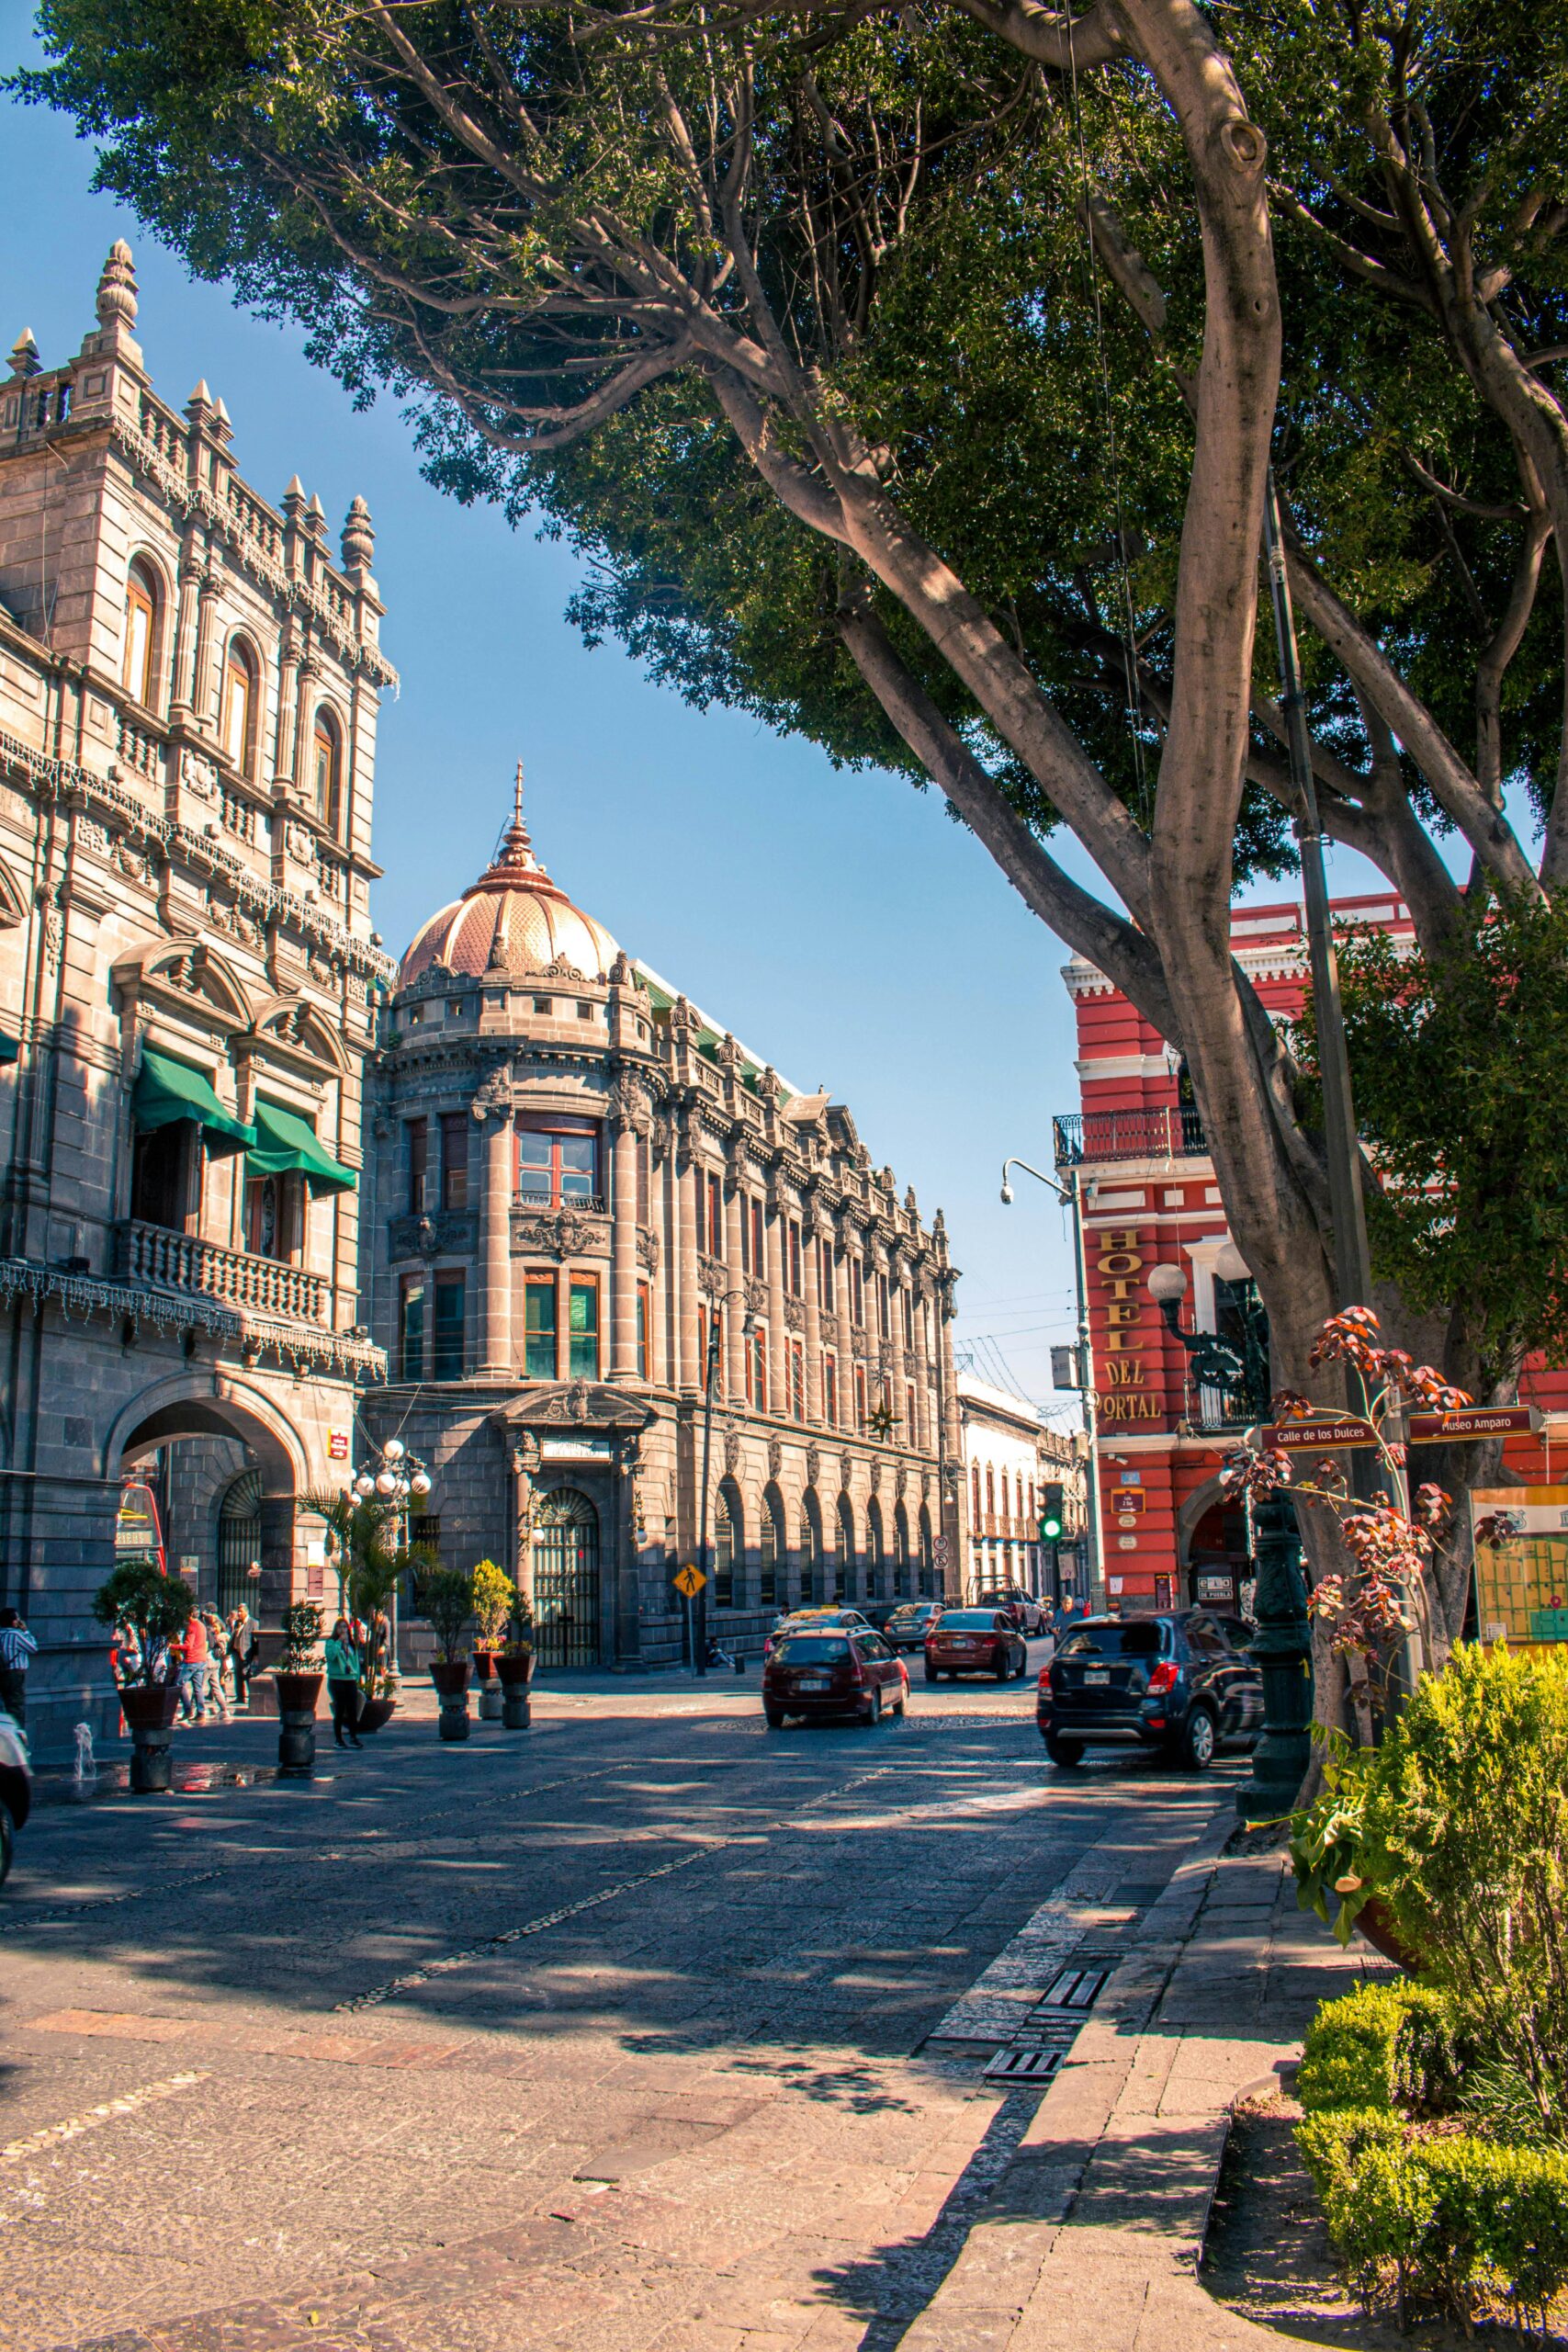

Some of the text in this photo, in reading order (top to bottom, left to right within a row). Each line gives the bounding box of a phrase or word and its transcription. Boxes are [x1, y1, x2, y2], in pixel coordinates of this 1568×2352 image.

[1097, 1229, 1144, 1351] HOTEL
[1104, 1360, 1145, 1385] DEL
[1441, 1417, 1512, 1431] Museo Amparo
[1277, 1427, 1365, 1442] Calle de los Dulces
